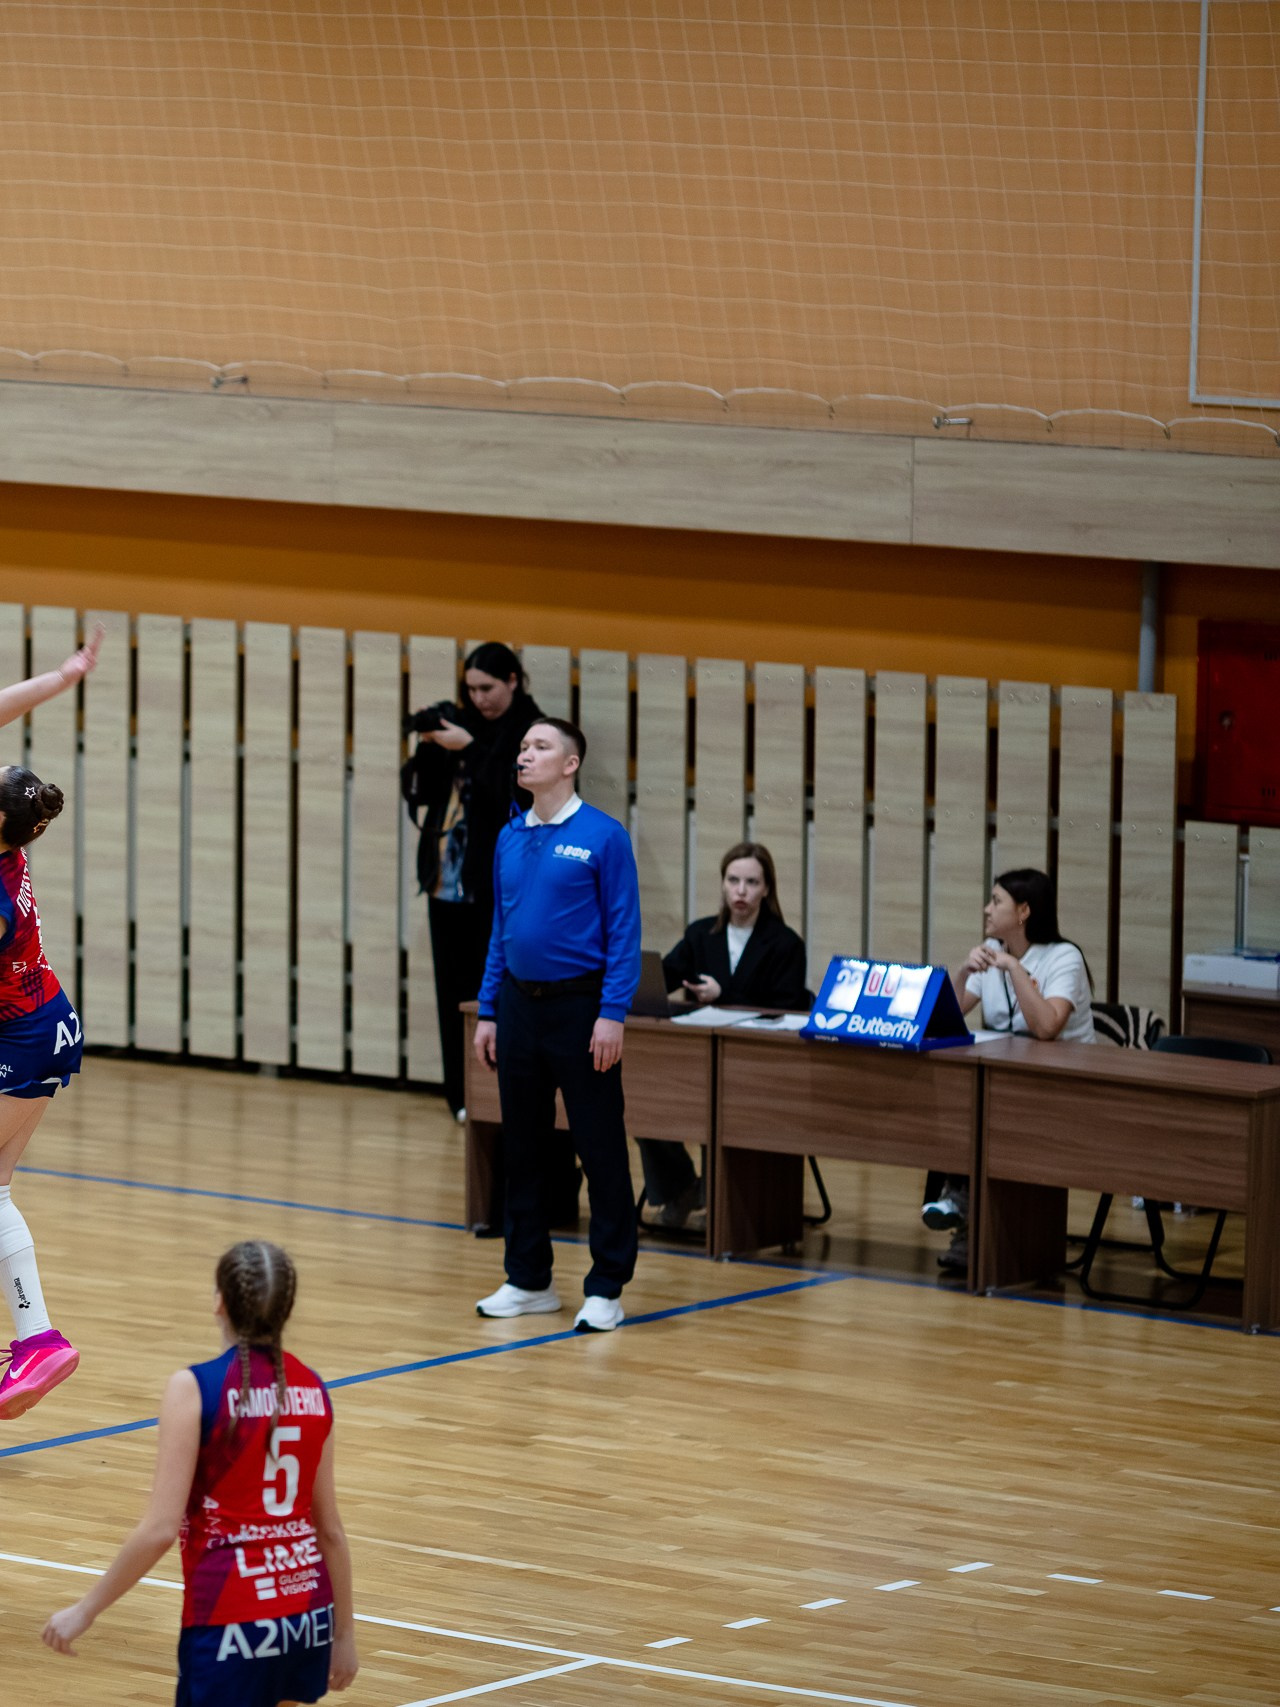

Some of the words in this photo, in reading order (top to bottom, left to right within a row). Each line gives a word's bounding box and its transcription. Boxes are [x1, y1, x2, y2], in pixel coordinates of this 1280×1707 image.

[847, 1014, 919, 1041] Butterfly
[262, 1426, 302, 1517] 5
[235, 1535, 323, 1578] LIME
[278, 1568, 321, 1585] GLOBAL
[280, 1580, 319, 1596] VISION
